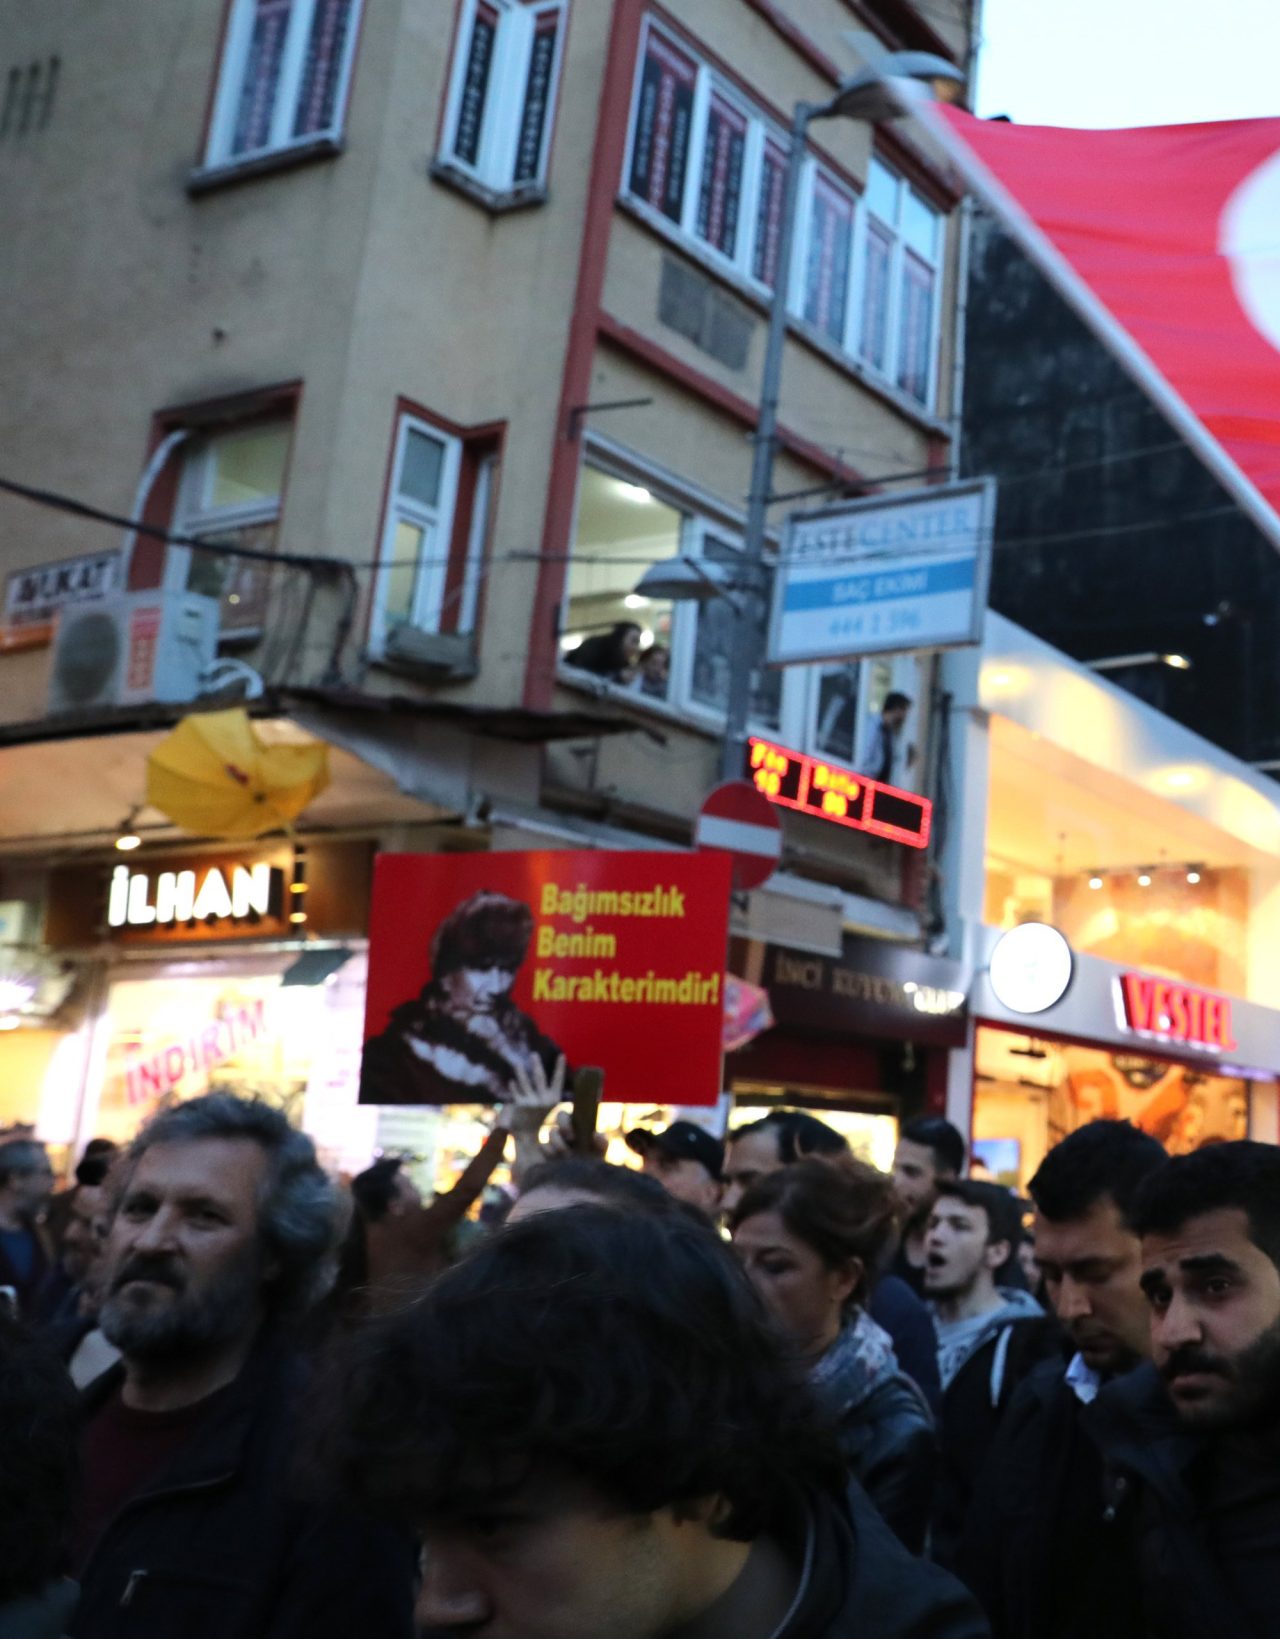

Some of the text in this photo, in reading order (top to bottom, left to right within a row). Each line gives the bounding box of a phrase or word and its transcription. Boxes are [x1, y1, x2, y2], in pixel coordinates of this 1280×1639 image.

[108, 864, 270, 927] İLHAN
[540, 882, 686, 924] Bağımsızlık
[536, 925, 617, 959] Benim
[532, 968, 720, 1005] Karakterimdir!
[1122, 971, 1237, 1052] VESTEL
